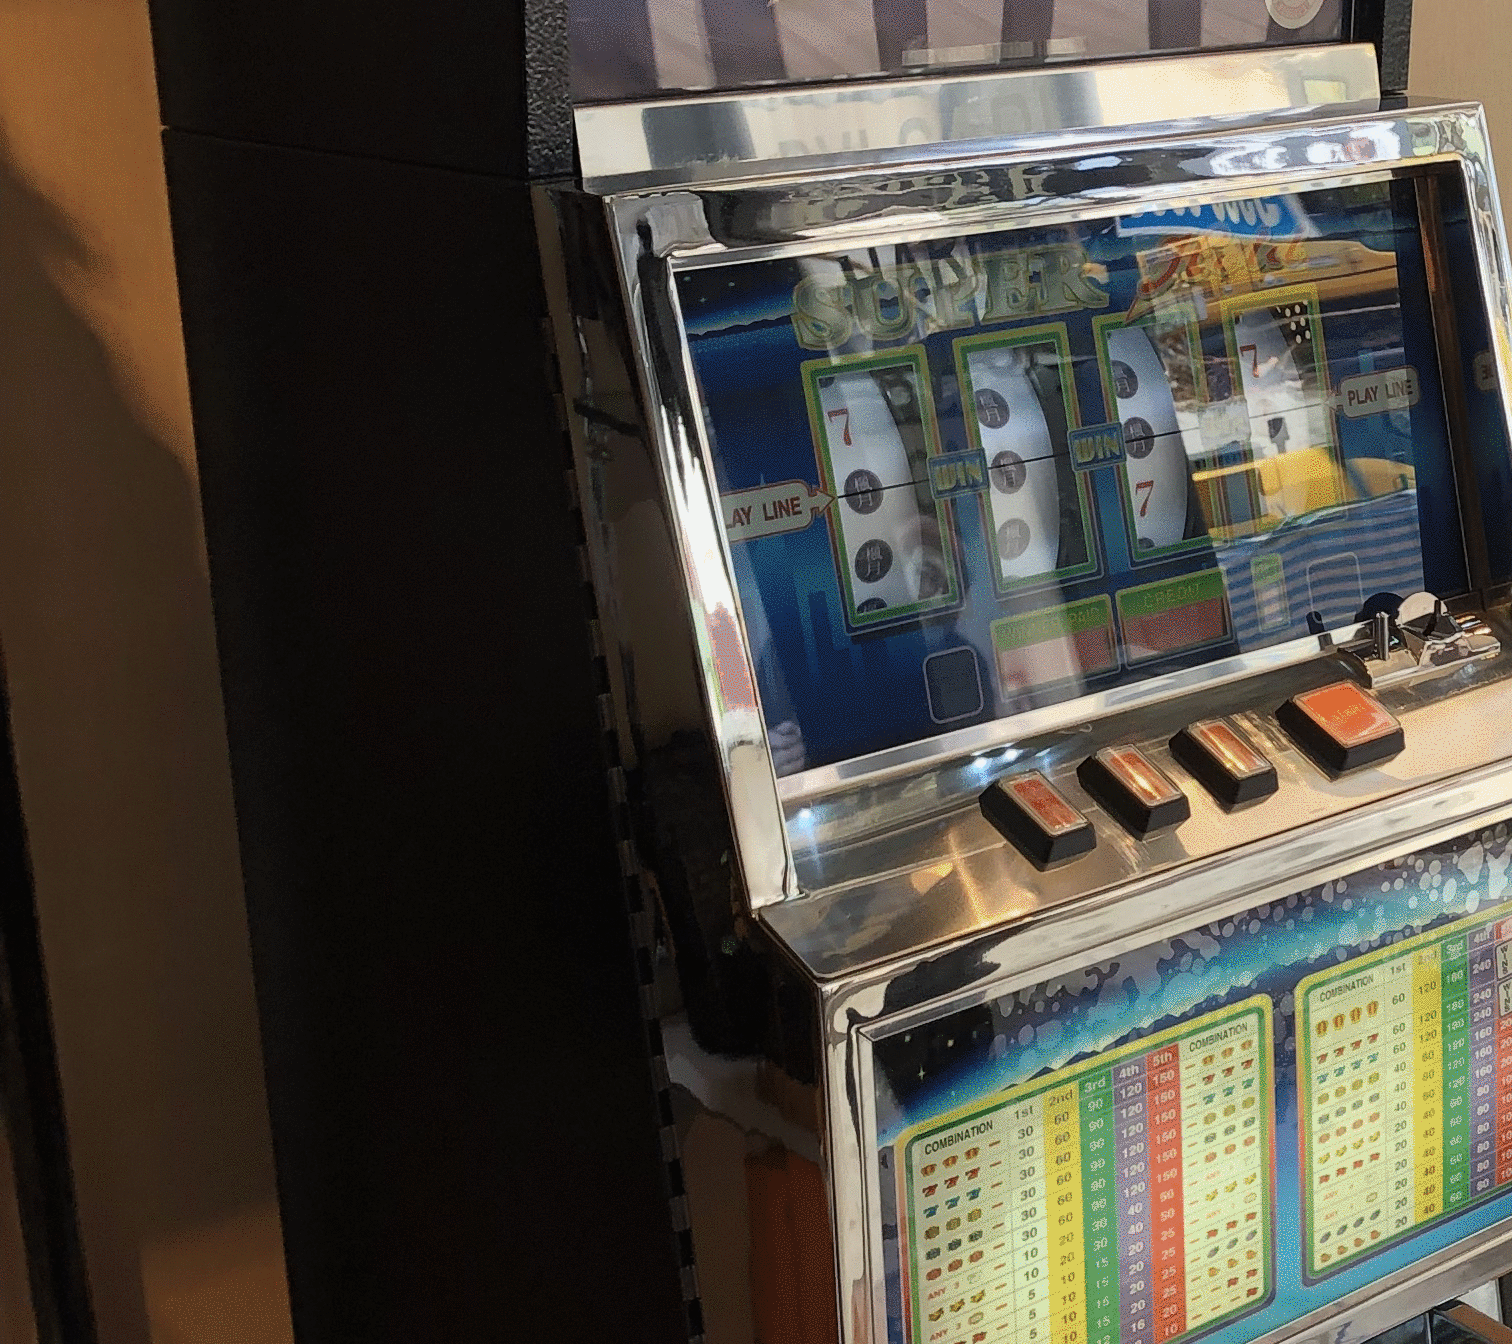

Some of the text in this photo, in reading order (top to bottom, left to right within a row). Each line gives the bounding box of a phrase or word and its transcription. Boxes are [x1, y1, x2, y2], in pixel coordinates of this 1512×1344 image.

[791, 243, 1110, 351] SUPER
[1347, 379, 1414, 407] PLAY LINE
[827, 408, 852, 446] 7
[1073, 431, 1120, 464] WIN
[934, 459, 984, 491] WIN
[725, 496, 803, 530] LAY LINE
[1135, 480, 1155, 517] 7
[1319, 973, 1374, 1002] COMBINATION
[1390, 962, 1406, 975] 1st
[1392, 993, 1405, 1005] 60
[1472, 960, 1491, 974] 240
[1393, 1022, 1405, 1034] 60
[1393, 1042, 1406, 1054] 60
[924, 1022, 1248, 1155] COMBINATION 1st 2nd 3rd 4th 5th COMBINATION
[1018, 1126, 1034, 1139] 30
[1120, 1082, 1142, 1099] 120
[1395, 1120, 1407, 1133] 20
[1018, 1146, 1034, 1160] 30
[1121, 1102, 1143, 1119] 120
[1395, 1140, 1407, 1152] 20
[1019, 1166, 1035, 1180] 30
[1121, 1122, 1143, 1138] 120
[1395, 1159, 1407, 1171] 20
[1020, 1187, 1036, 1200] 30
[1122, 1142, 1144, 1158] 120
[1395, 1178, 1407, 1190] 20
[1021, 1207, 1037, 1220] 30
[1123, 1162, 1145, 1178] 120
[1395, 1197, 1407, 1210] 20
[1022, 1227, 1038, 1241] 30
[1058, 1212, 1073, 1226] 60
[1123, 1182, 1145, 1198] 120
[1395, 1216, 1407, 1229] 20
[1024, 1248, 1038, 1261] 10
[1127, 1202, 1143, 1215] 40
[1024, 1268, 1039, 1281] 10
[1128, 1222, 1144, 1235] 40
[1028, 1289, 1036, 1300] 5
[1128, 1242, 1144, 1256] 20
[1029, 1309, 1036, 1320] 5
[1062, 1292, 1076, 1305] 10
[1129, 1261, 1144, 1275] 20
[1030, 1328, 1037, 1339] 5
[1062, 1311, 1076, 1324] 10
[1129, 1280, 1144, 1294] 20
[1064, 1332, 1077, 1344] 10
[1130, 1300, 1145, 1314] 20
[1131, 1319, 1145, 1332] 16
[1164, 1323, 1179, 1335] 10
